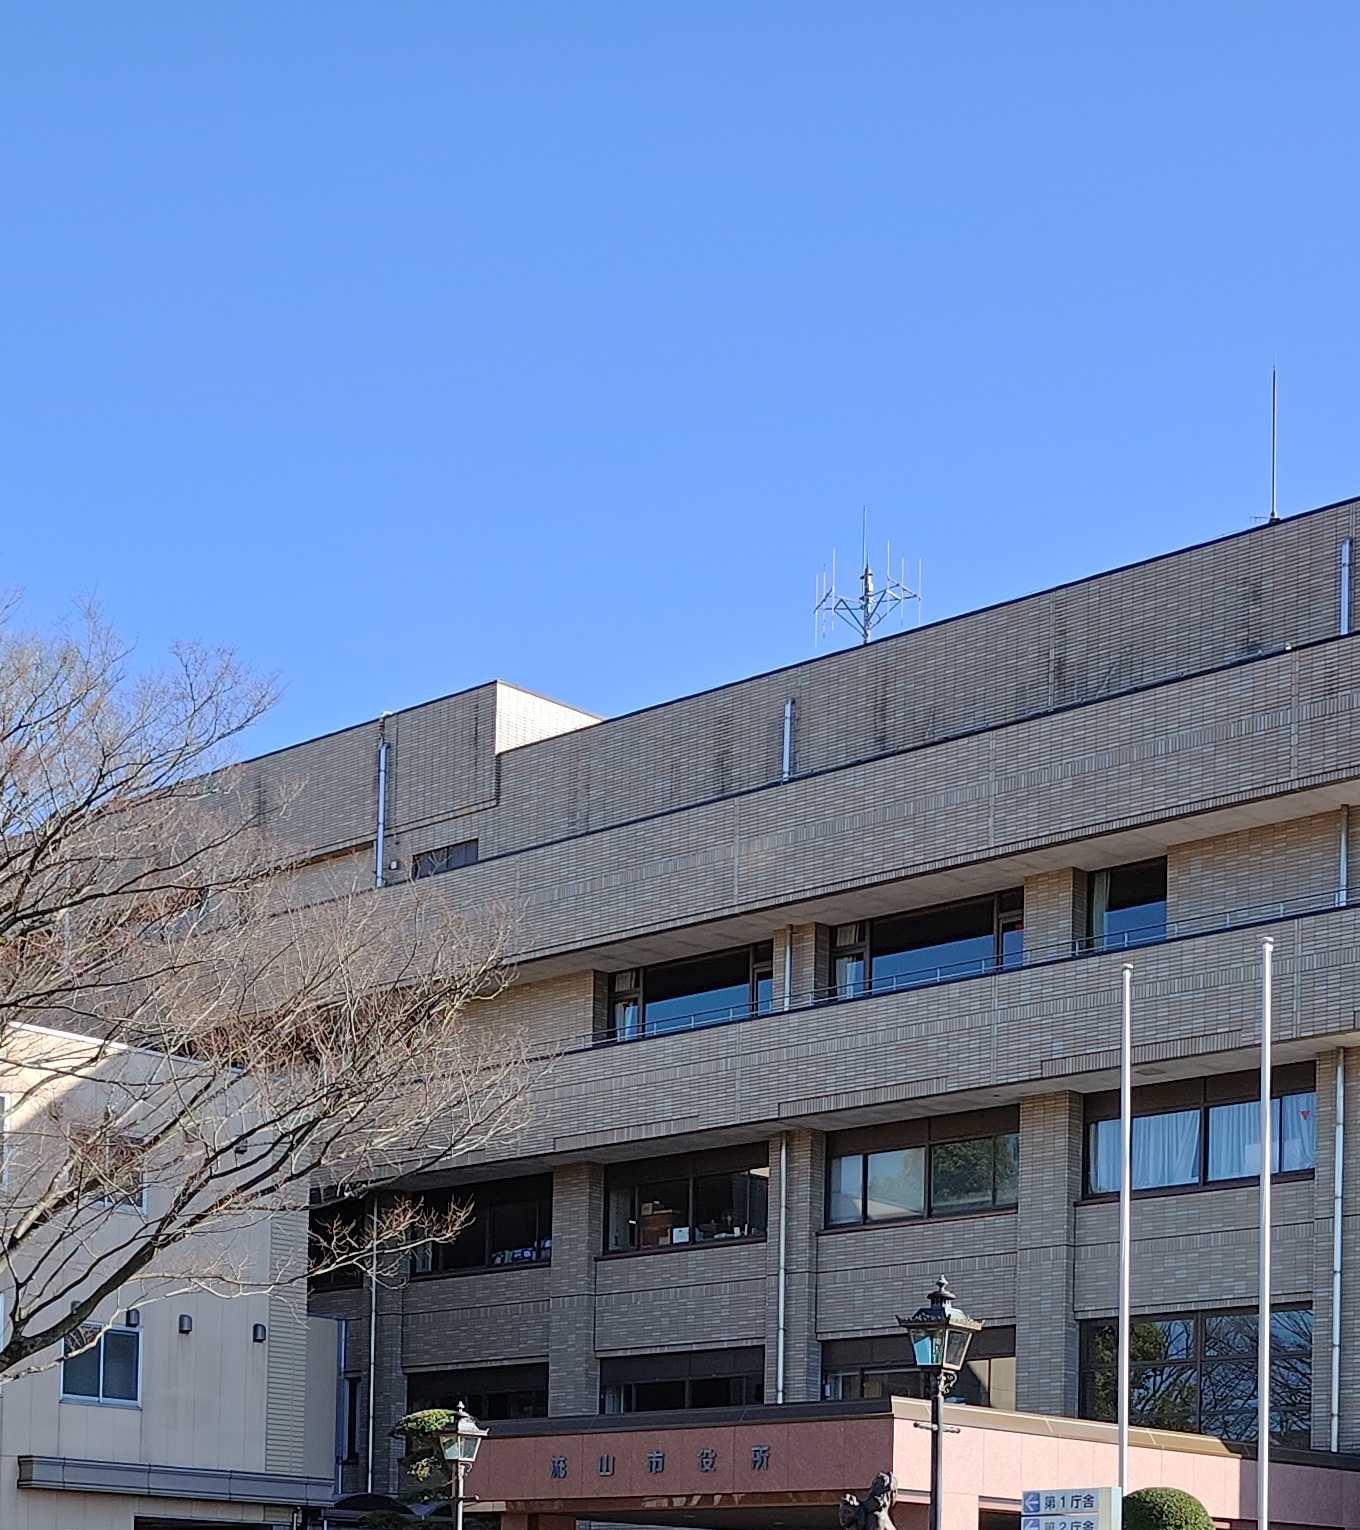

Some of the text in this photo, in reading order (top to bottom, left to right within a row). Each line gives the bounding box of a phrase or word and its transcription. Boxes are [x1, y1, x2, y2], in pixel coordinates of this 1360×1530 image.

[550, 1444, 770, 1479] 流山市役所
[1044, 1494, 1095, 1511] 第1庁舎
